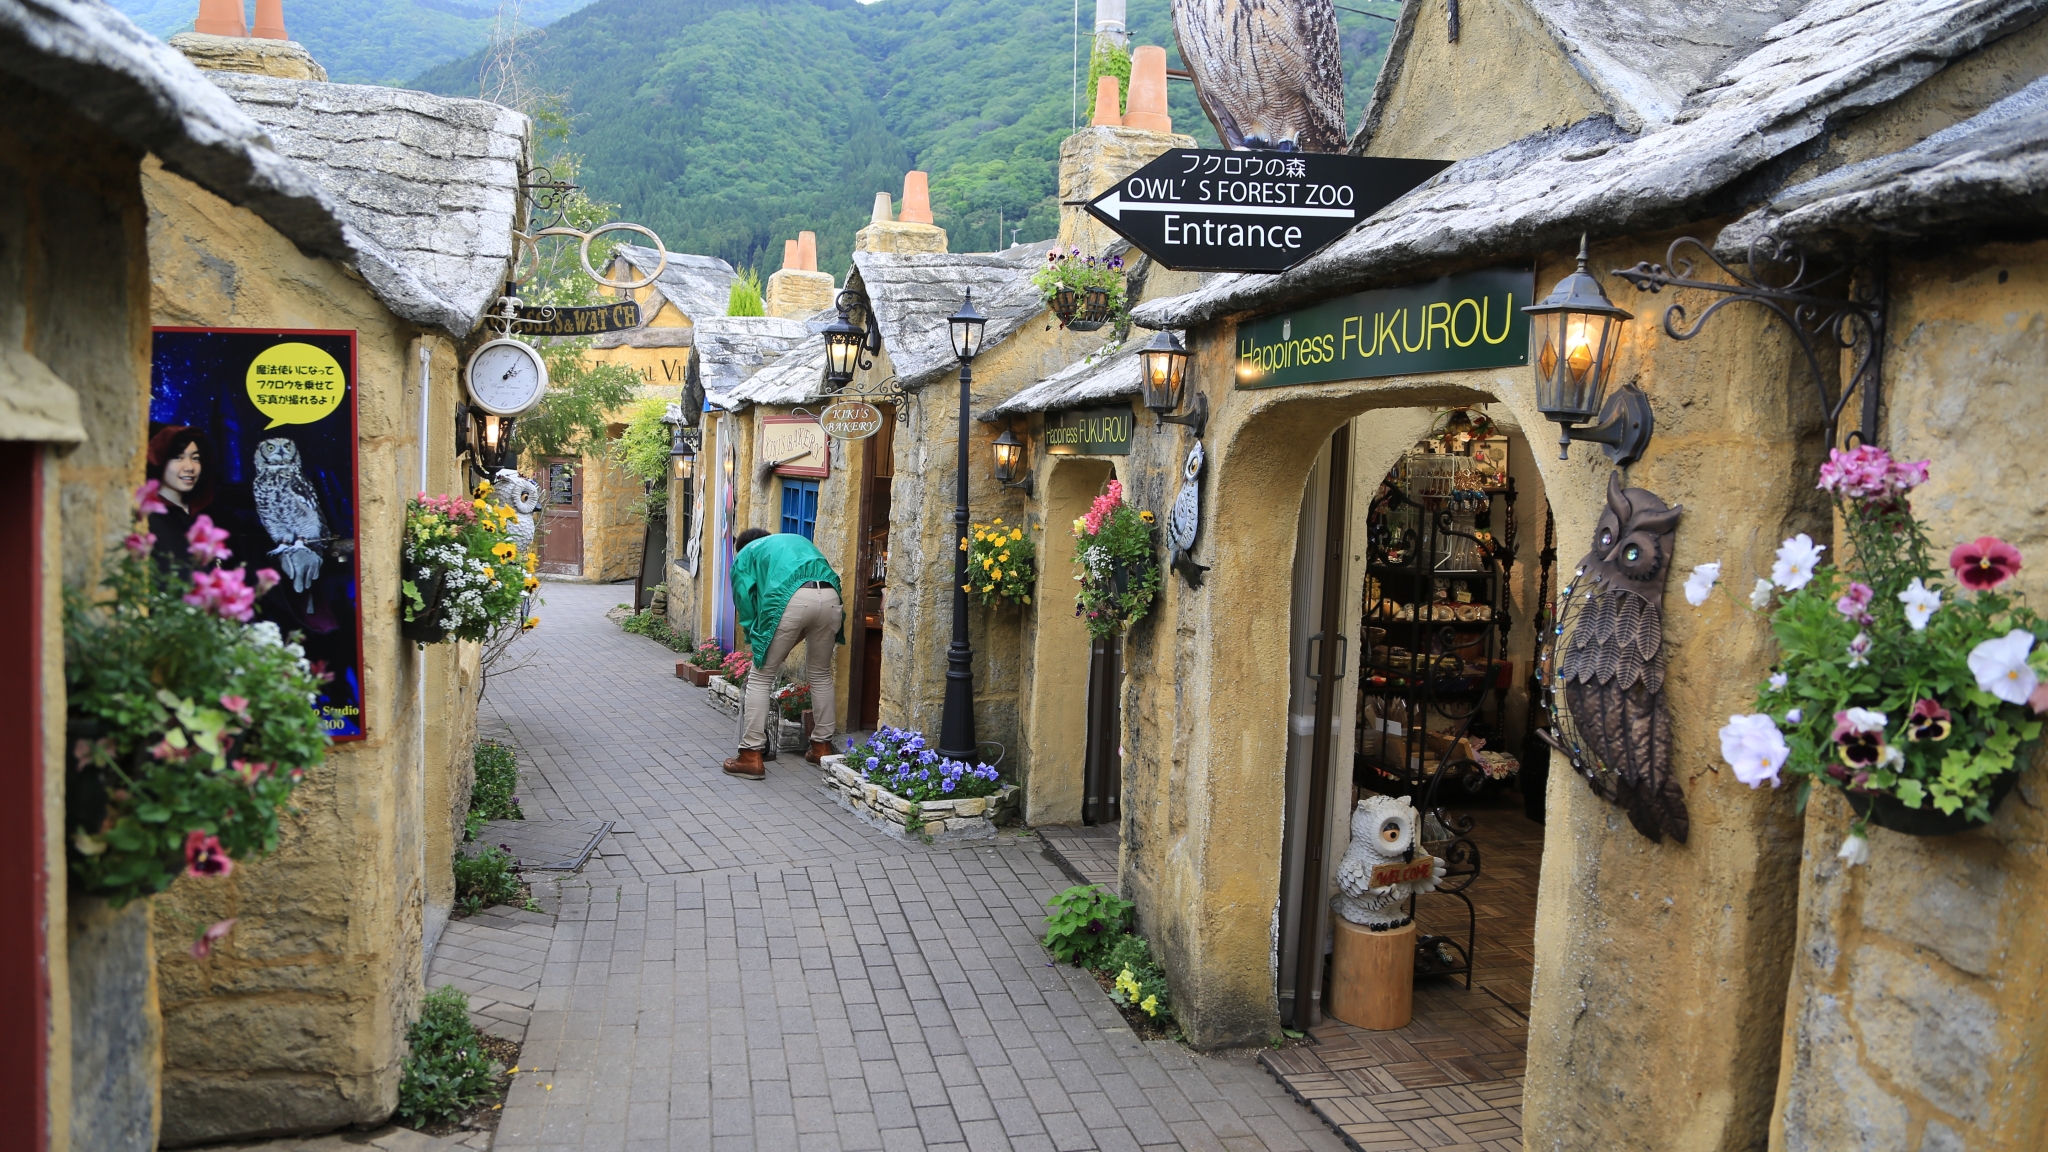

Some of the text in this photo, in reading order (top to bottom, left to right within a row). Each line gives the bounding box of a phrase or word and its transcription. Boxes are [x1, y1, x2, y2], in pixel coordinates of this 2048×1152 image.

[1181, 154, 1306, 178] フクロウの森
[1218, 181, 1300, 204] FOREST
[1305, 184, 1354, 206] ZOO
[1164, 214, 1302, 249] Entrance
[1240, 292, 1513, 374] Happiness FUKUROU
[256, 365, 334, 375] 魔法使いになって
[256, 380, 334, 390] フクロウを乗せて
[825, 420, 877, 432] BAKERY
[832, 408, 869, 420] KIKI'S
[1045, 415, 1128, 446] Happiness FUKUROU
[786, 427, 823, 461] BAKERY
[1376, 863, 1431, 885] WELCOME
